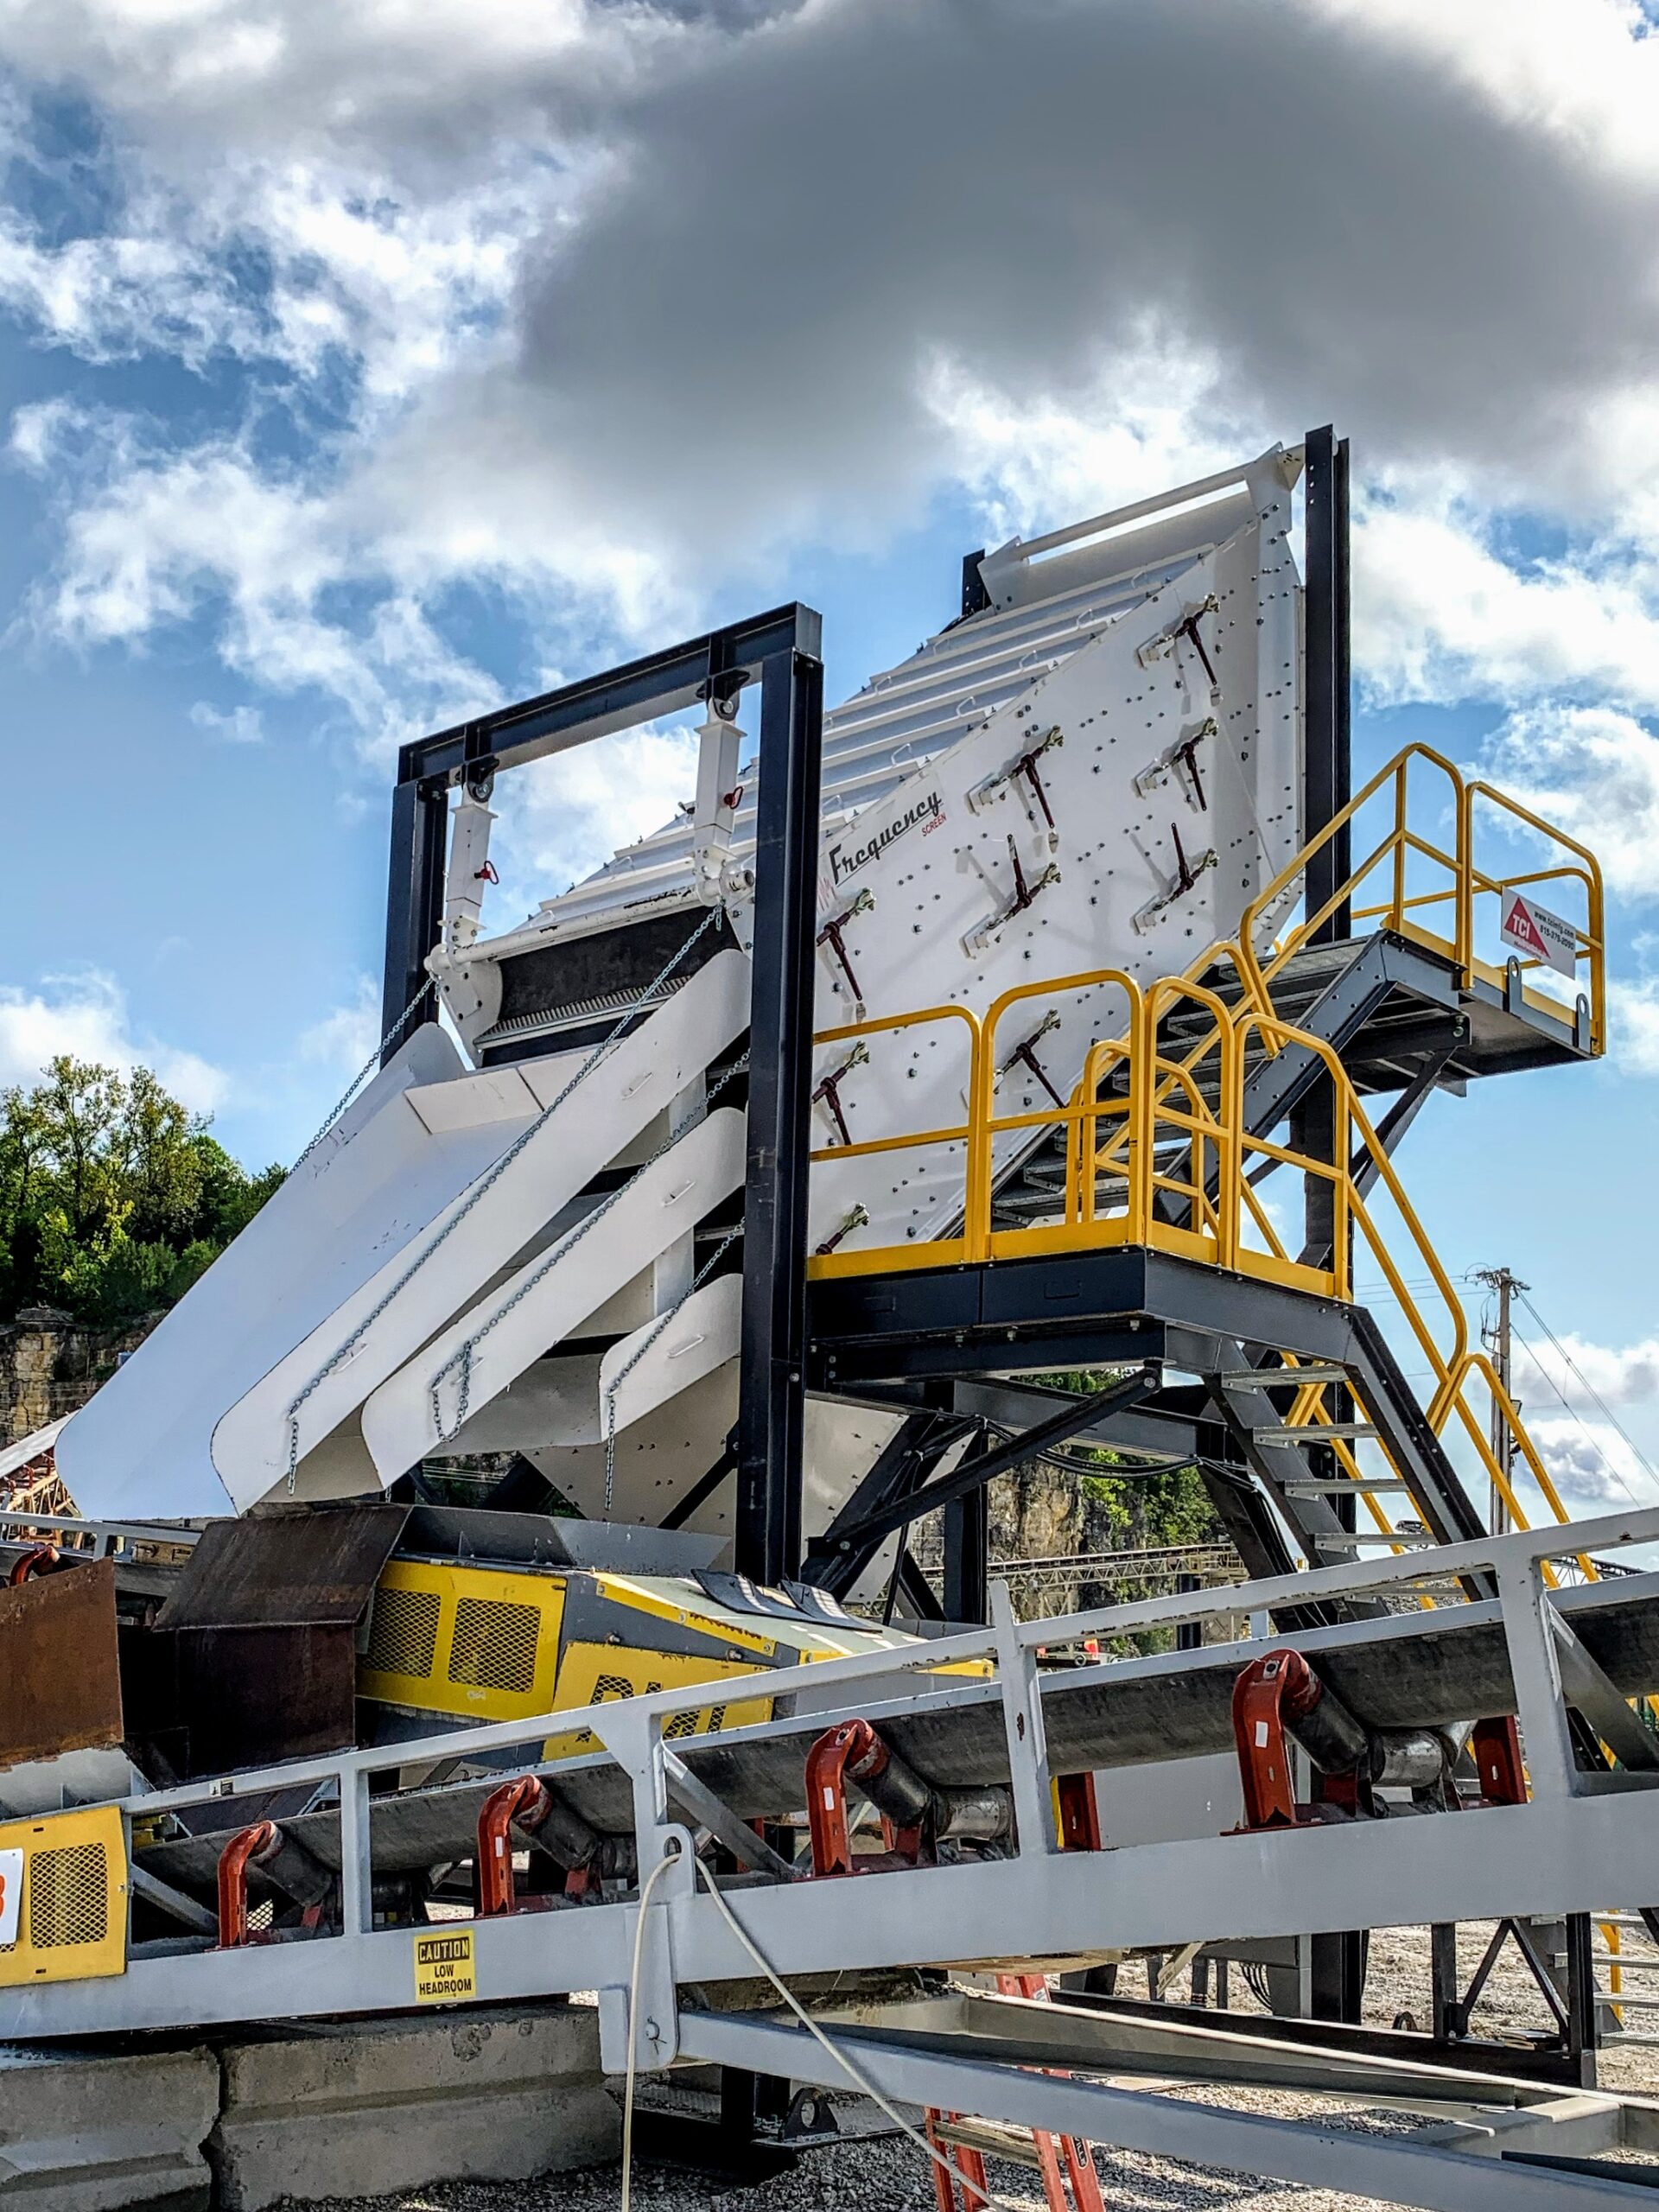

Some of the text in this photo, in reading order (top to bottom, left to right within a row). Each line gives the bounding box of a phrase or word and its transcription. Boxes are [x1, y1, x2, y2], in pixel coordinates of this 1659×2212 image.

[921, 812, 947, 836] SCREEN
[829, 791, 942, 885] Frequency
[1513, 913, 1530, 939] TCI
[419, 1940, 468, 1961] CAUTION
[435, 1964, 454, 1978] LOW
[419, 1978, 472, 1995] HEADROOM
